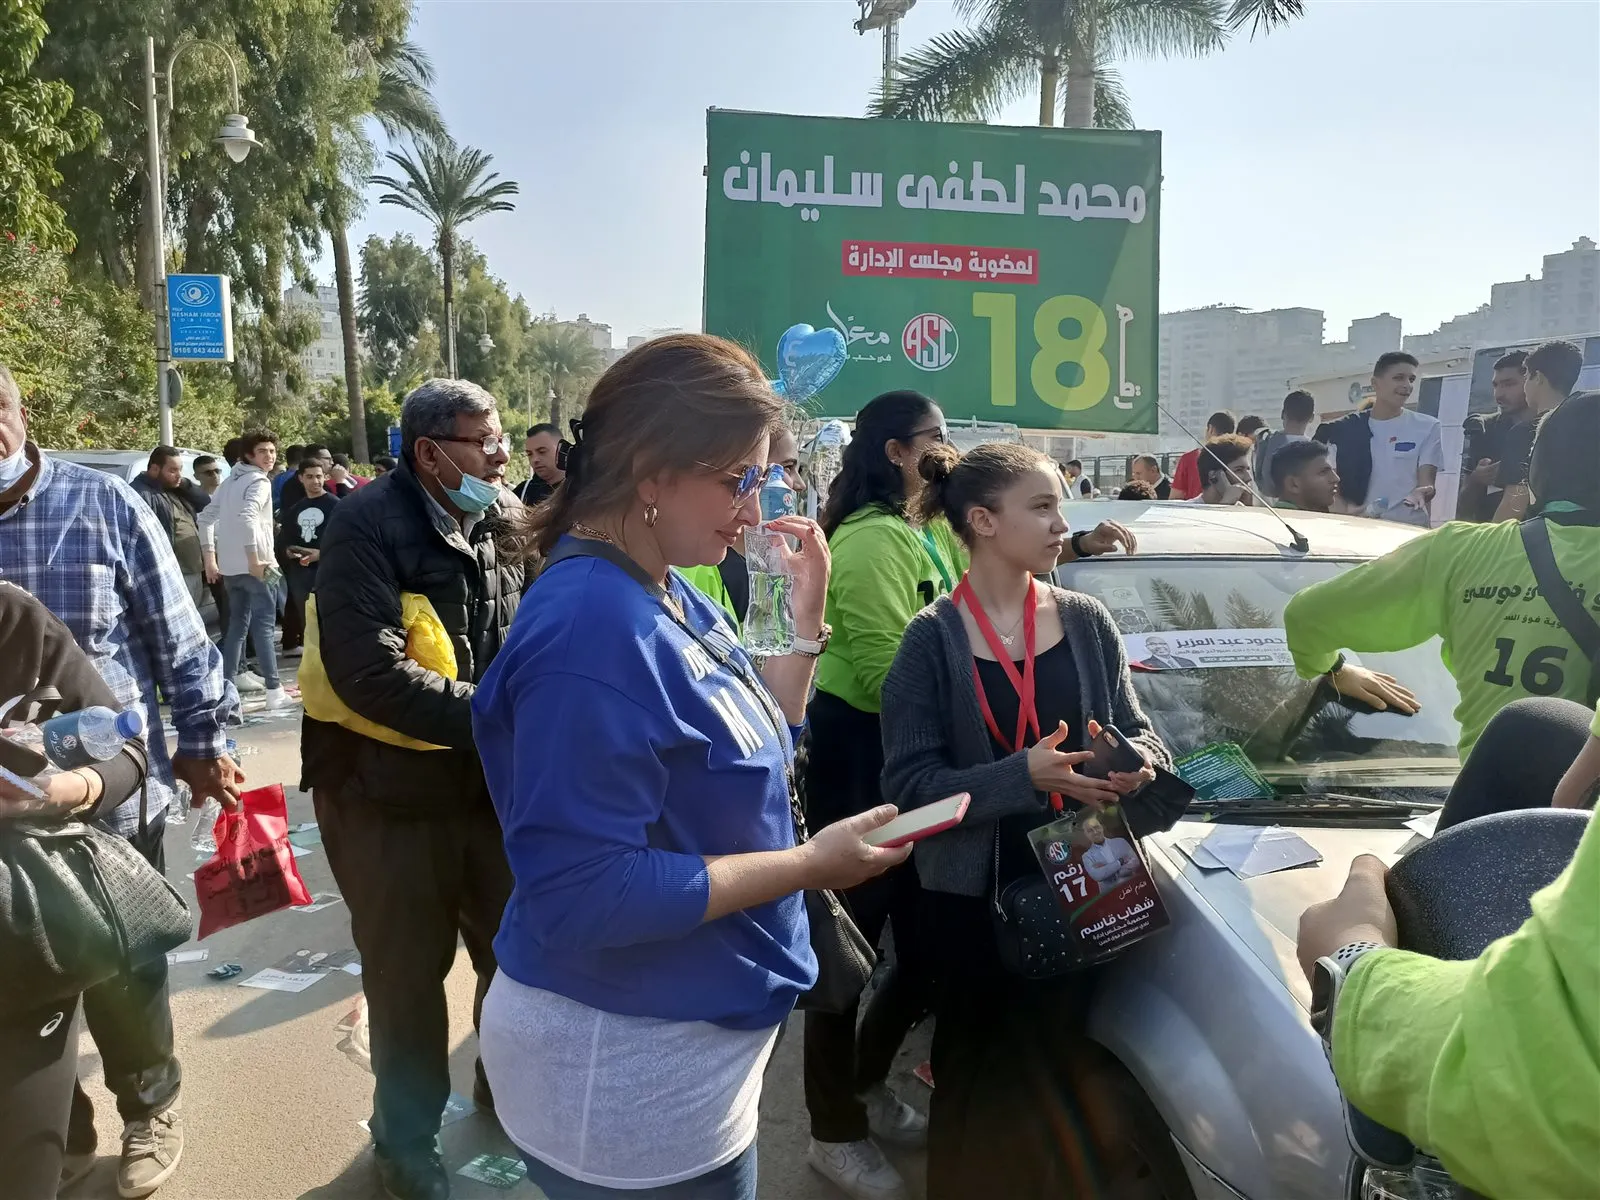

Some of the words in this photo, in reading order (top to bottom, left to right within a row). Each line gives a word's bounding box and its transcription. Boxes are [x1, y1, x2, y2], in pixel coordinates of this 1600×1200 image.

[722, 150, 883, 222] سليمان
[896, 160, 1026, 215] لطفى
[1037, 180, 1147, 224] محمد
[848, 243, 903, 274] الإدارة
[909, 248, 963, 276] مجلس
[968, 249, 1033, 278] لعضوية
[905, 315, 953, 369] ASC
[972, 291, 1111, 411] 18
[1175, 637, 1214, 649] العزيز
[1247, 637, 1287, 646] حمود
[1484, 637, 1569, 696] 16
[1053, 863, 1084, 885] رقم
[1059, 875, 1088, 903] 17
[1117, 896, 1155, 921] شهاب
[1080, 913, 1117, 939] قاسم
